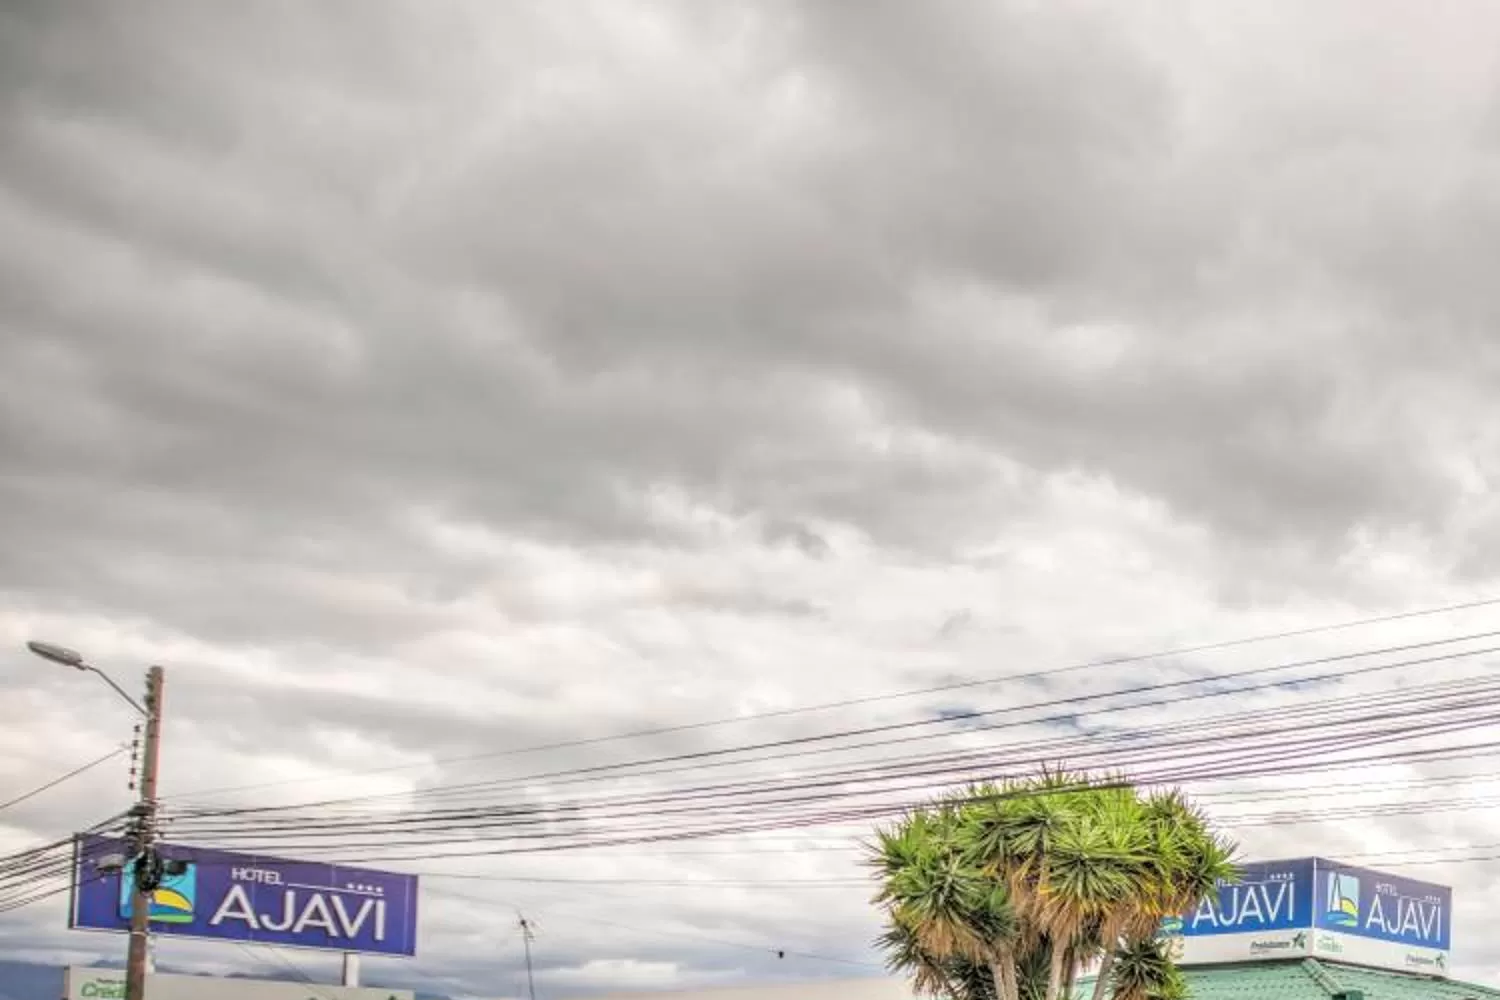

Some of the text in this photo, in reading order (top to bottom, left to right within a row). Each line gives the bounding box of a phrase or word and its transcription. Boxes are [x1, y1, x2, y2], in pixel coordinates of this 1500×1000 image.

[232, 867, 284, 884] HOTEL
[209, 884, 386, 941] AJAVI
[1191, 881, 1295, 929] AJAVI
[1365, 893, 1441, 943] AJAVI
